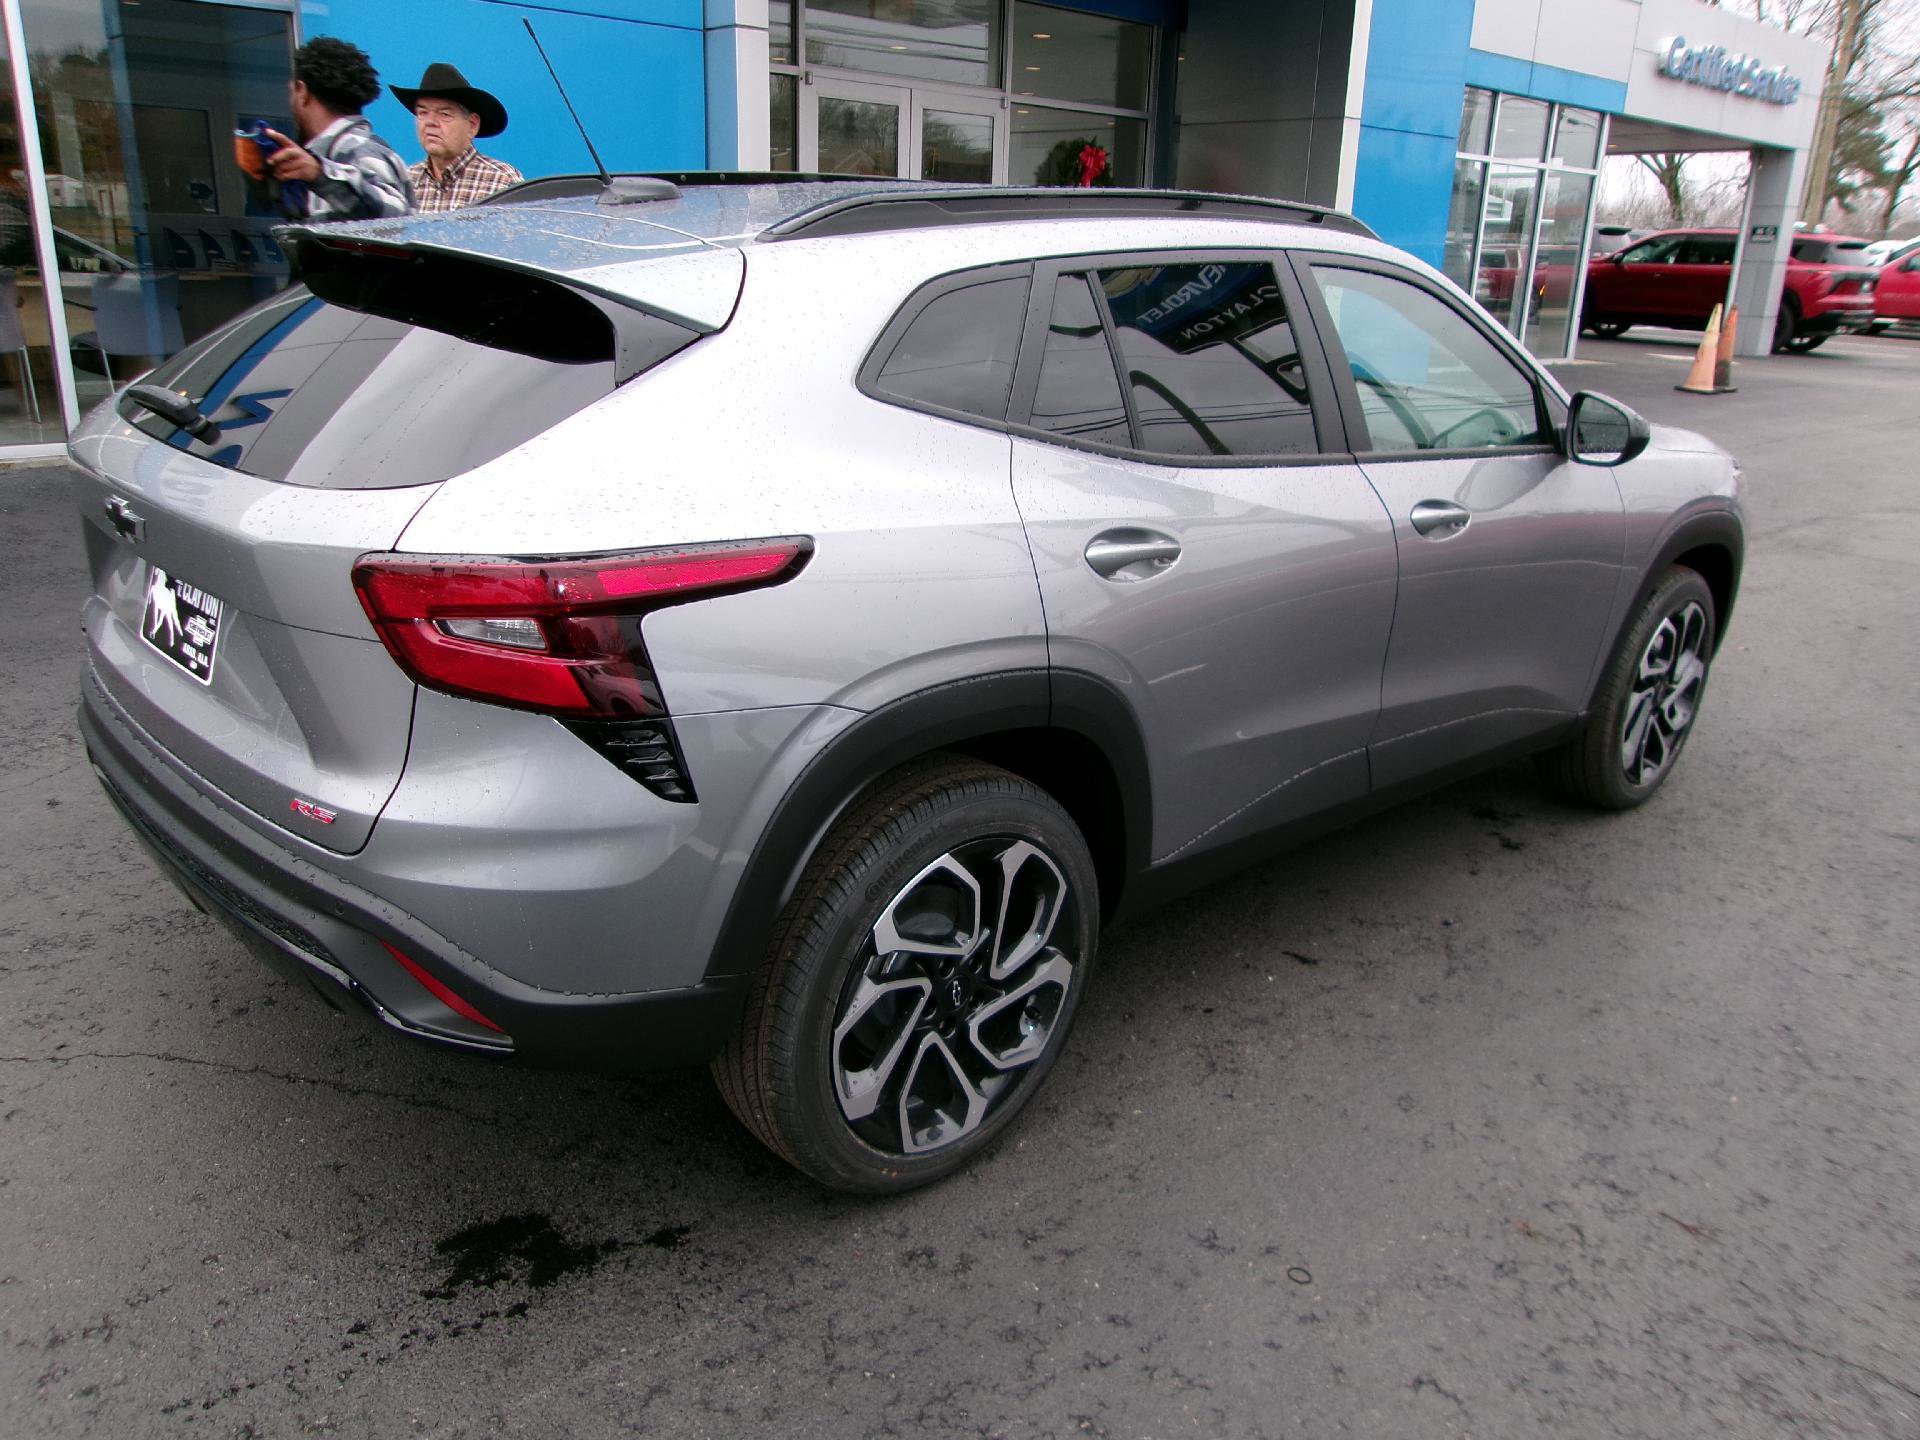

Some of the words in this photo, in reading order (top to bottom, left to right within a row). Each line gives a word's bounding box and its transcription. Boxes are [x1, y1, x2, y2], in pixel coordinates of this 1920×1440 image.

[1667, 35, 1747, 91] Certified
[182, 583, 220, 619] CLAYTON
[290, 798, 338, 824] RS
